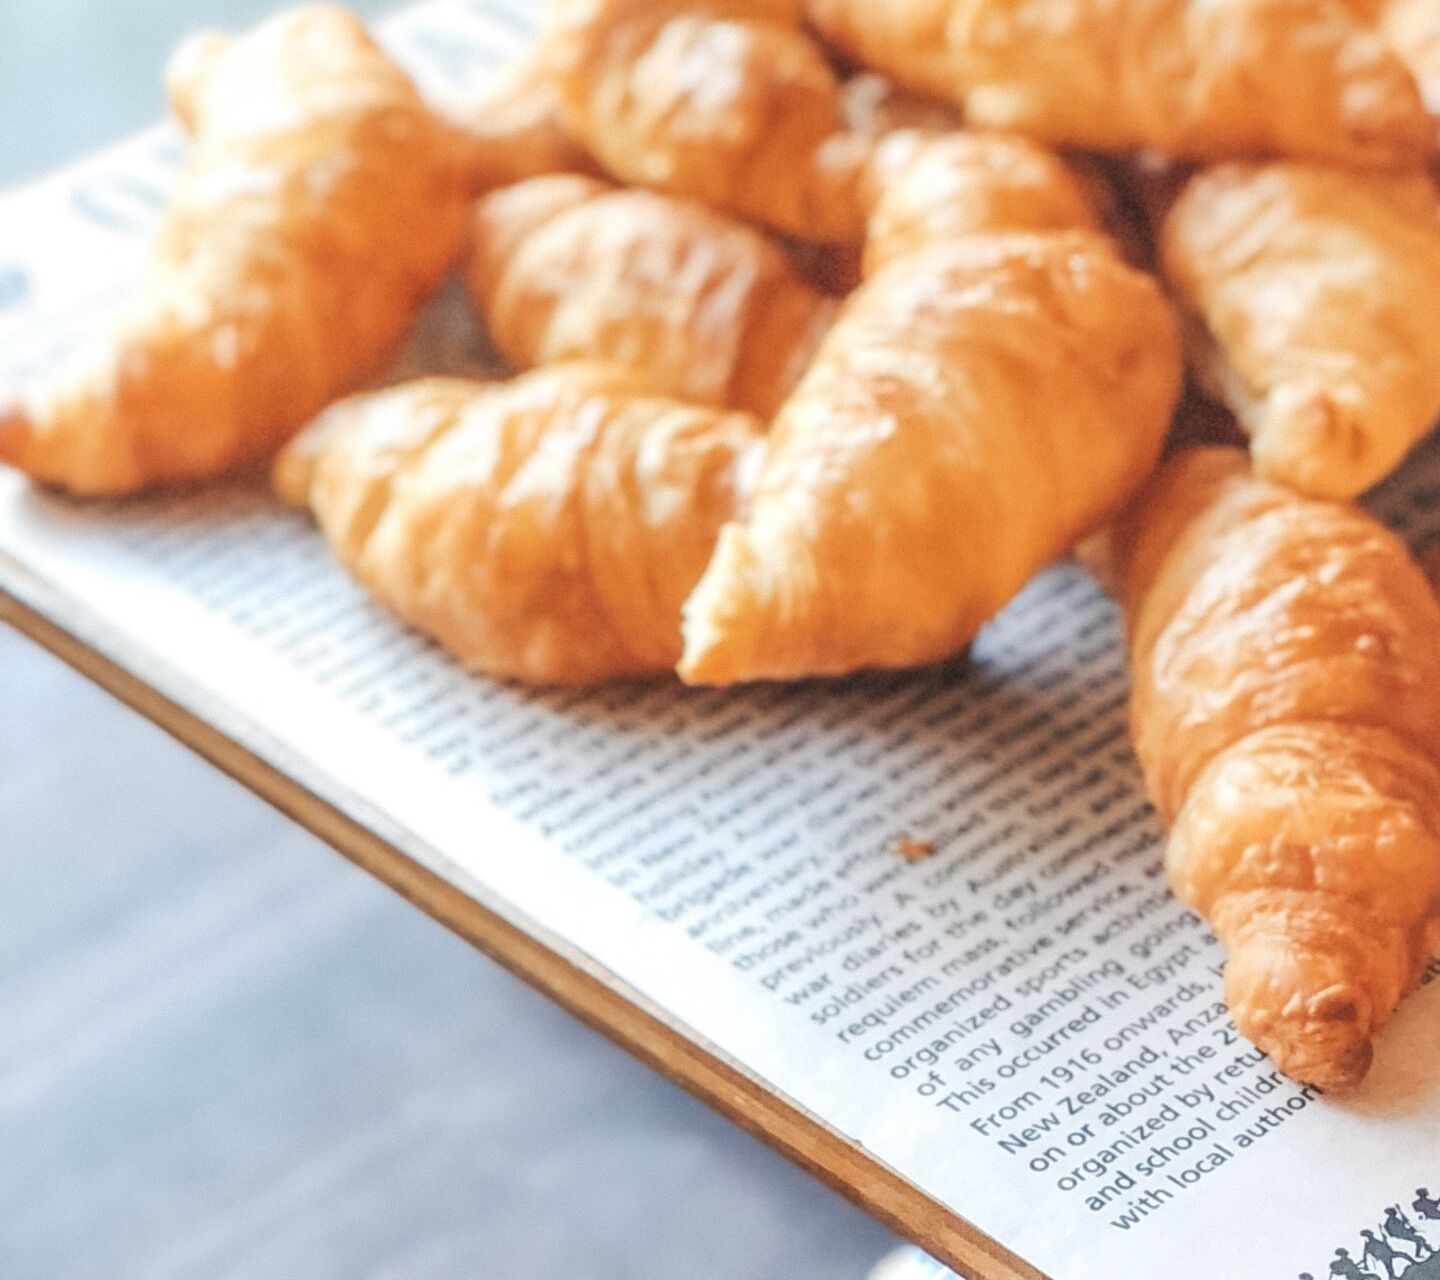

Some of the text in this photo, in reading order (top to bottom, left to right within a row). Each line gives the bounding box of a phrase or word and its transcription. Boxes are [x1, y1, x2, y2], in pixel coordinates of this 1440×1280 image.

[785, 974, 831, 1004] war
[843, 922, 922, 970] diaries
[925, 898, 959, 917] by
[811, 881, 1036, 1024] soldiers for the day
[837, 977, 939, 1043] requiem
[864, 938, 1053, 1060] commemorative
[890, 949, 1088, 1078] organized sports
[917, 912, 1201, 1095] of any gambling going
[936, 945, 1199, 1112] This occurred in Egypt
[970, 1092, 1042, 1135] From
[1040, 1049, 1102, 1088] 1916
[1104, 983, 1213, 1050] onwards,
[998, 1003, 1229, 1154] New Zealand, Anza
[1030, 1046, 1217, 1171] on or about the
[1058, 1047, 1269, 1190] organized by retu
[1086, 1070, 1289, 1210] and school childr
[1111, 1190, 1173, 1229] with
[1167, 1144, 1233, 1188] local
